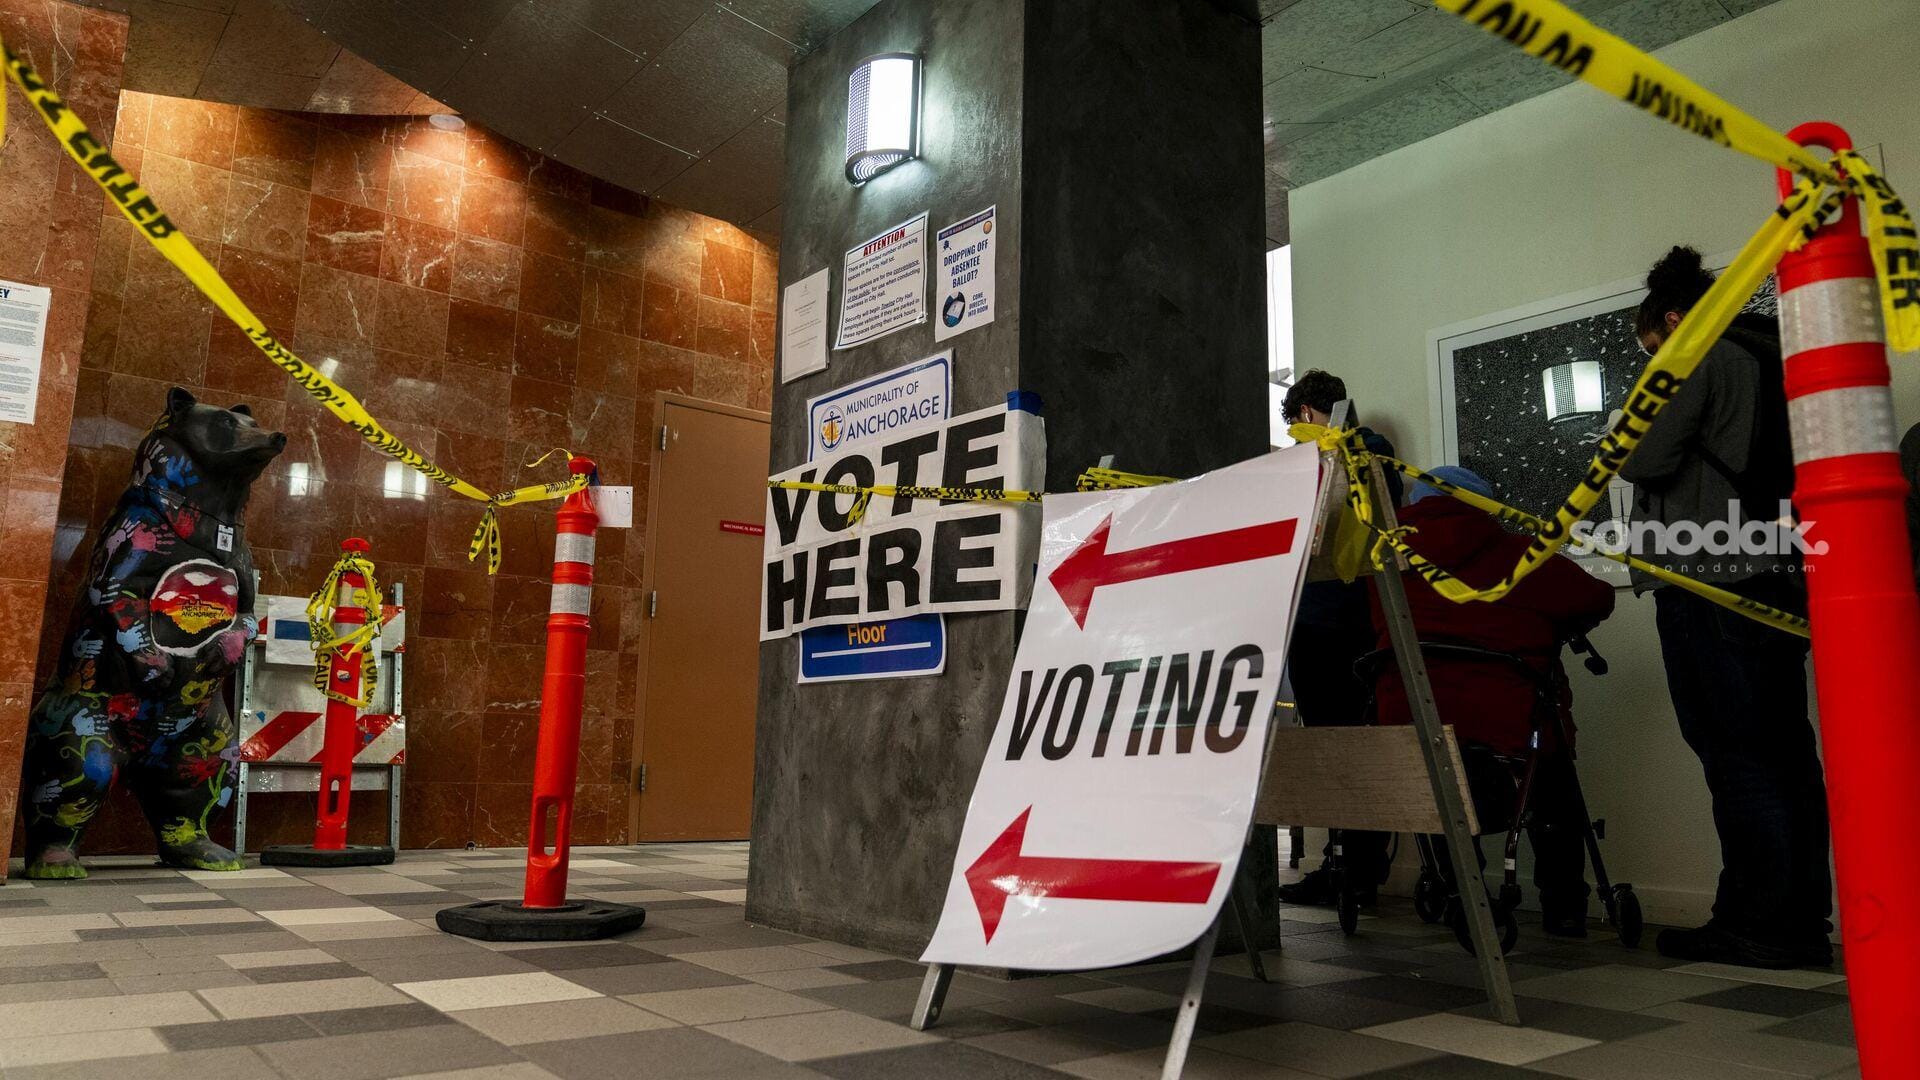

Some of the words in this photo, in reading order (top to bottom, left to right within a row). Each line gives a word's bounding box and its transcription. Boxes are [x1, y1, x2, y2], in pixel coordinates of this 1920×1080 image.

[863, 228, 906, 257] ATTENTION
[882, 247, 897, 257] number
[902, 237, 918, 248] parking
[943, 244, 976, 267] DROPPING
[977, 238, 989, 252] OFF
[951, 255, 980, 277] ABSENTEE
[952, 269, 979, 289] BALLOT?
[845, 314, 861, 323] Security
[846, 385, 905, 416] MUNICIPALITY
[906, 380, 919, 395] OF
[845, 395, 940, 442] ANCHORAGE
[770, 412, 1006, 547] VOTE
[767, 513, 1001, 633] HERE
[848, 623, 887, 645] Floor
[1005, 643, 1264, 761] VOTING
